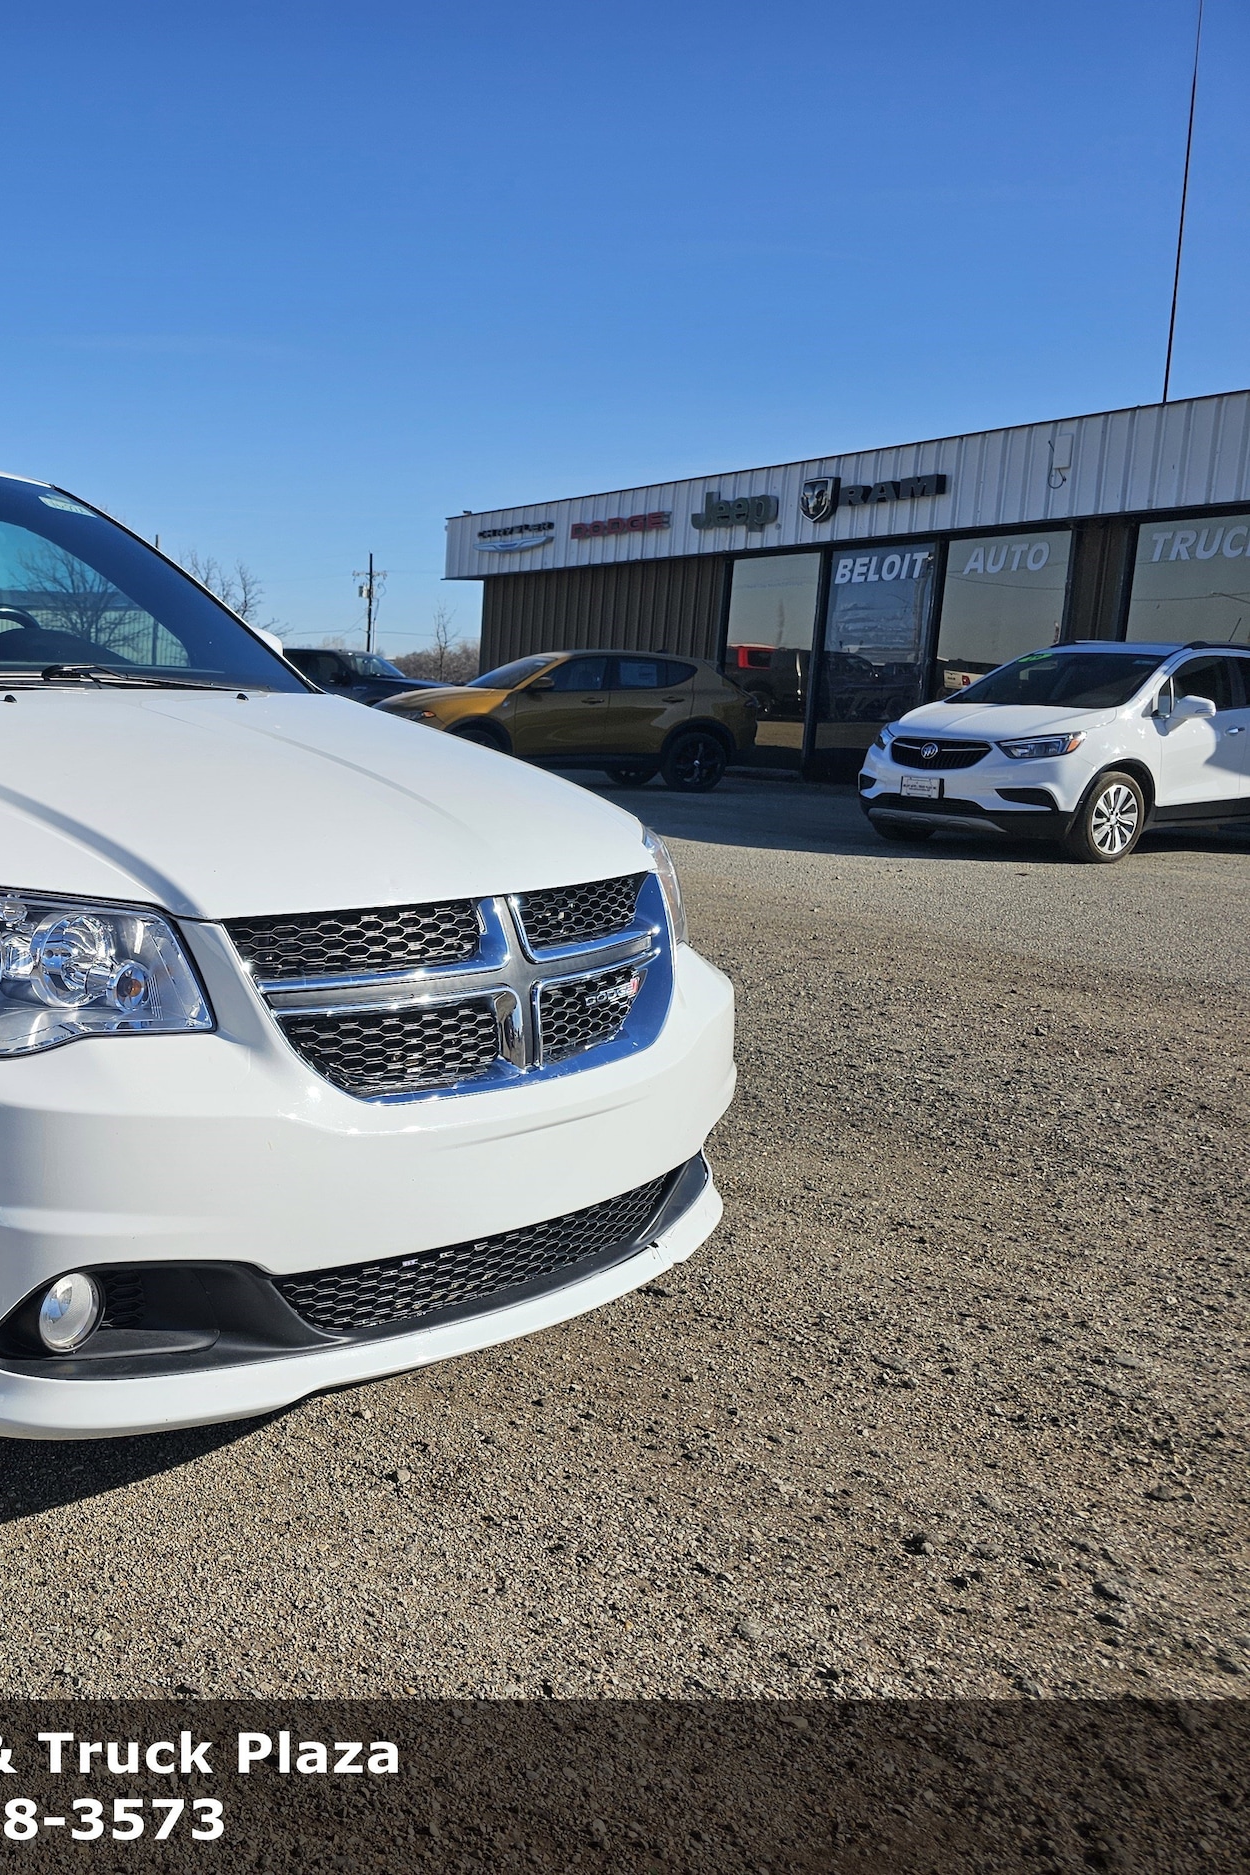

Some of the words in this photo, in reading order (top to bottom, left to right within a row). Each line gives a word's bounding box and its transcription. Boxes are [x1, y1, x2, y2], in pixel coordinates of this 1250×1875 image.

[839, 474, 946, 506] RAM
[571, 511, 669, 539] DODGE
[691, 491, 778, 532] Jeep
[834, 552, 930, 584] BELOIT
[963, 541, 1050, 575] AUTO
[1151, 525, 1250, 562] TRUC
[584, 982, 636, 1006] DODGE
